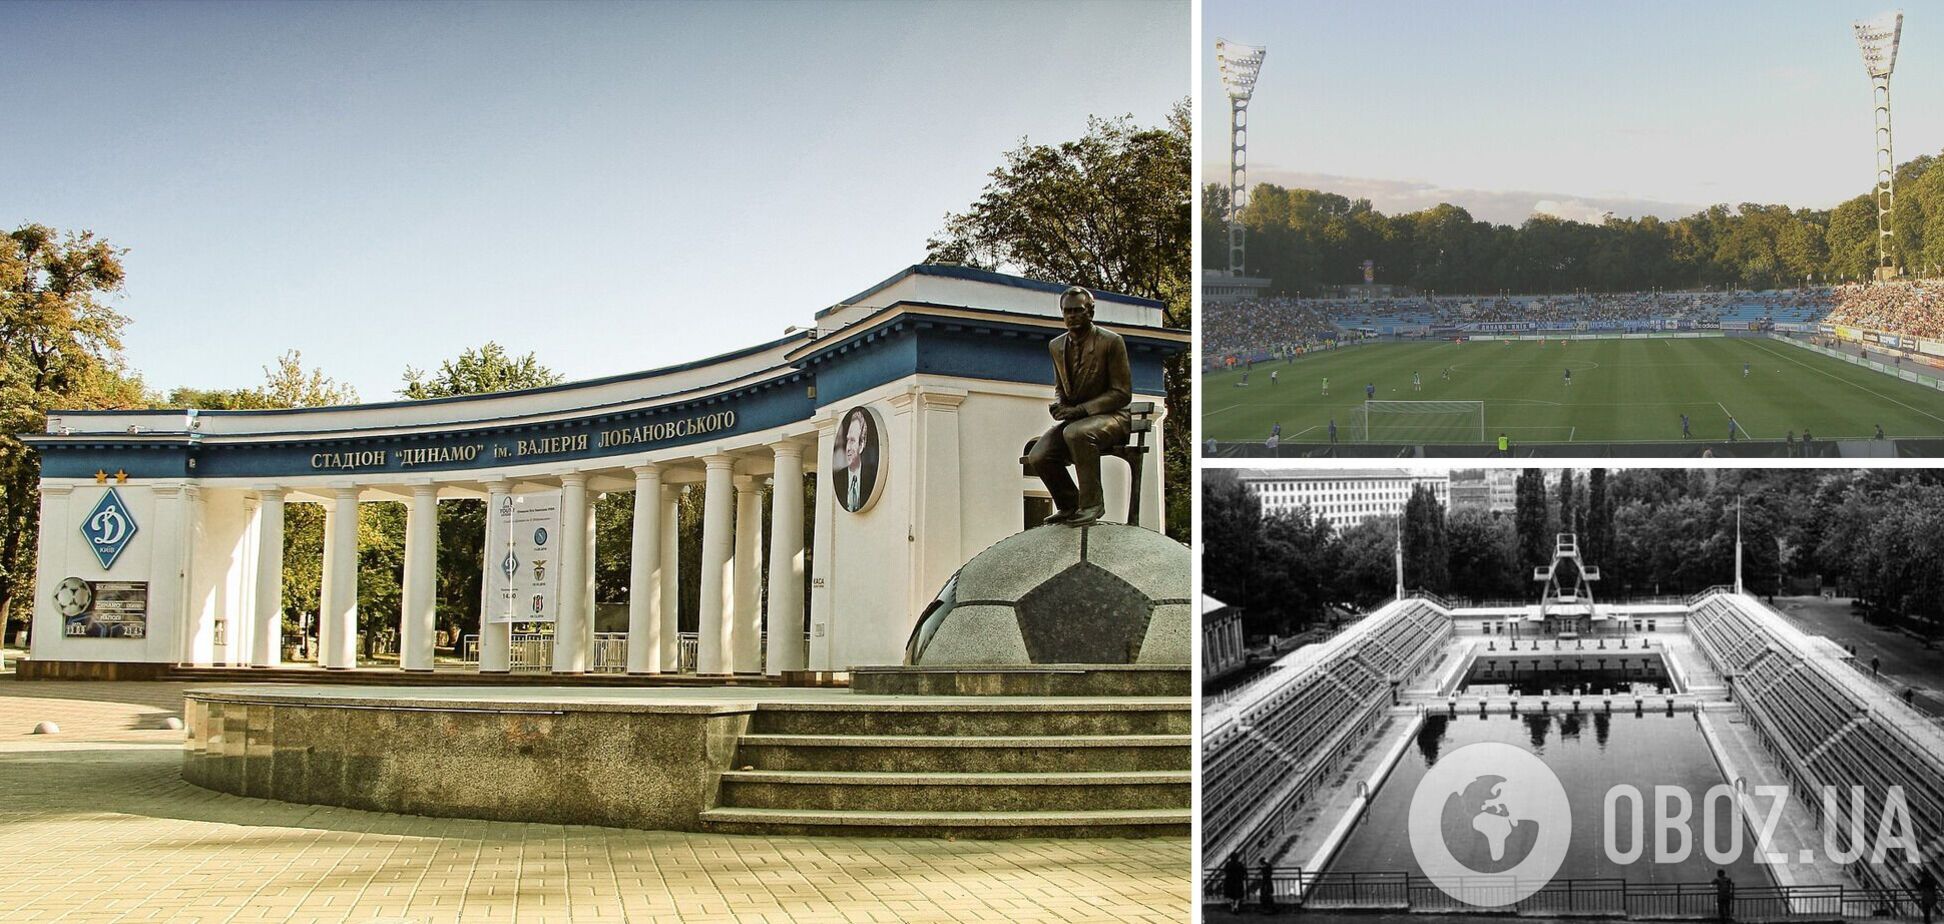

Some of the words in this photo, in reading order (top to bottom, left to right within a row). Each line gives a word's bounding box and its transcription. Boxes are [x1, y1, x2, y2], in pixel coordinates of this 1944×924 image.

[311, 450, 386, 469] СТАДІОН
[494, 443, 512, 458] ім.
[517, 433, 589, 456] ВАЛЕРІЯ
[597, 410, 736, 448] ЛОБАНОВСЬКОГО
